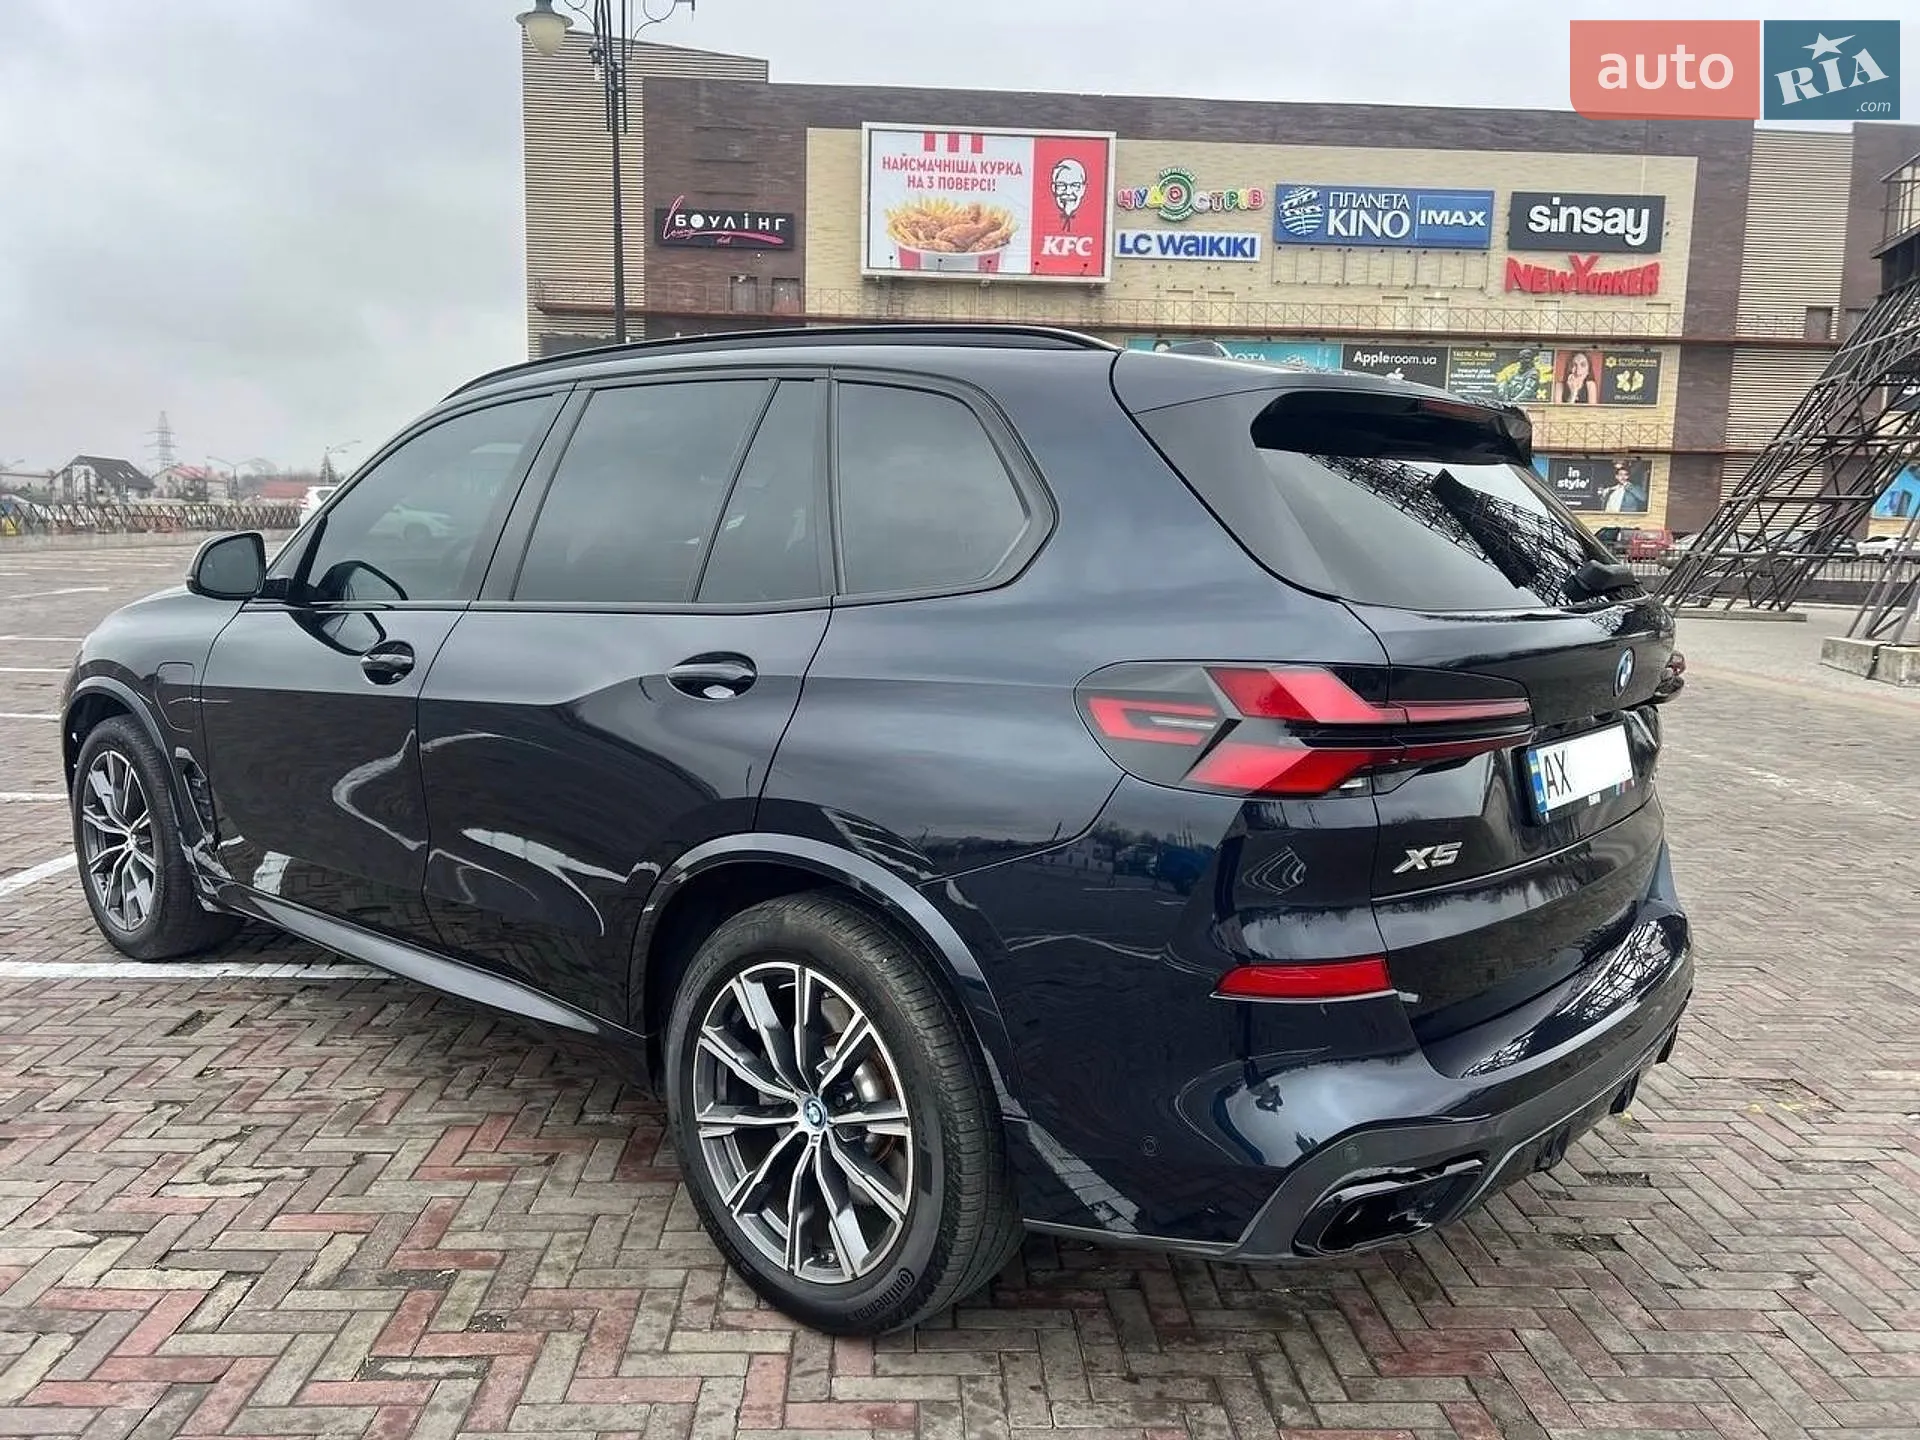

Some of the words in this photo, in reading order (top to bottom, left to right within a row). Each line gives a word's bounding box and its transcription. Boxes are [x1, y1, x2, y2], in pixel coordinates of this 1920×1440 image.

[882, 153, 977, 174] НАЙСМАЧНІША
[980, 162, 1023, 176] КУРКА
[907, 176, 924, 189] НА
[927, 177, 935, 190] 3
[938, 177, 996, 192] ПОВЕРСІ!
[675, 213, 786, 231] БОУЛІНГ
[1327, 209, 1410, 238] KINO
[1420, 209, 1486, 226] IMAX
[1528, 197, 1650, 246] sinsay
[1041, 235, 1094, 256] KFC
[1119, 233, 1151, 254] LC
[1353, 351, 1437, 367] Appleroom.ua
[1568, 467, 1580, 477] in
[1544, 750, 1572, 800] AX
[1391, 841, 1463, 874] X5
